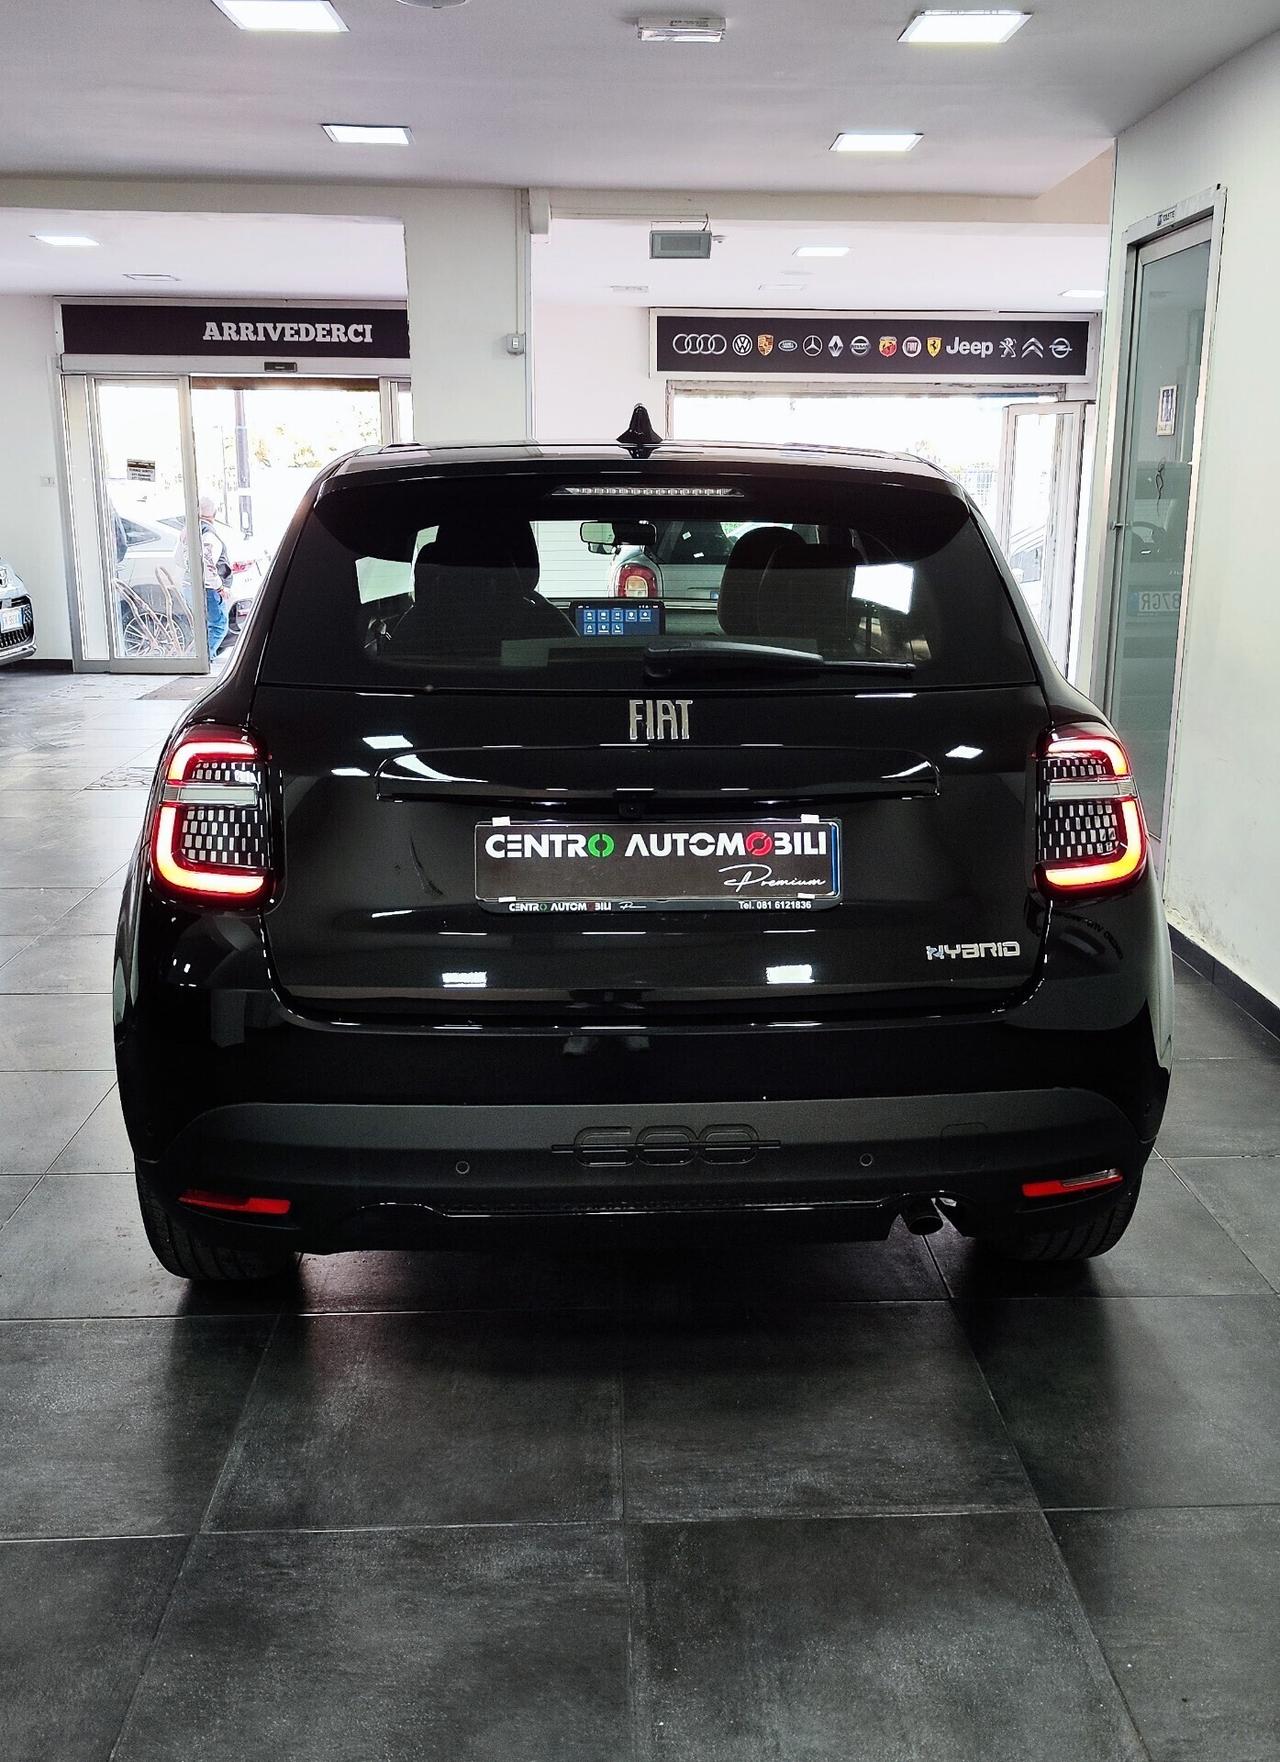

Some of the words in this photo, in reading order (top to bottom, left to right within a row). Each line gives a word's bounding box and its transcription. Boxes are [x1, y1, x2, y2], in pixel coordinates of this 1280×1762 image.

[203, 322, 373, 343] ARRIVEDERCI
[946, 336, 993, 358] Jeep
[629, 699, 693, 740] FIAT
[485, 833, 615, 858] CENTRO
[624, 831, 827, 857] AUTOMOBILI
[718, 864, 826, 892] Premium
[508, 902, 548, 912] CENTRO
[738, 901, 755, 909] Tel.
[756, 901, 771, 909] 081
[774, 901, 812, 909] 6121836
[926, 941, 1020, 960] HYBRID
